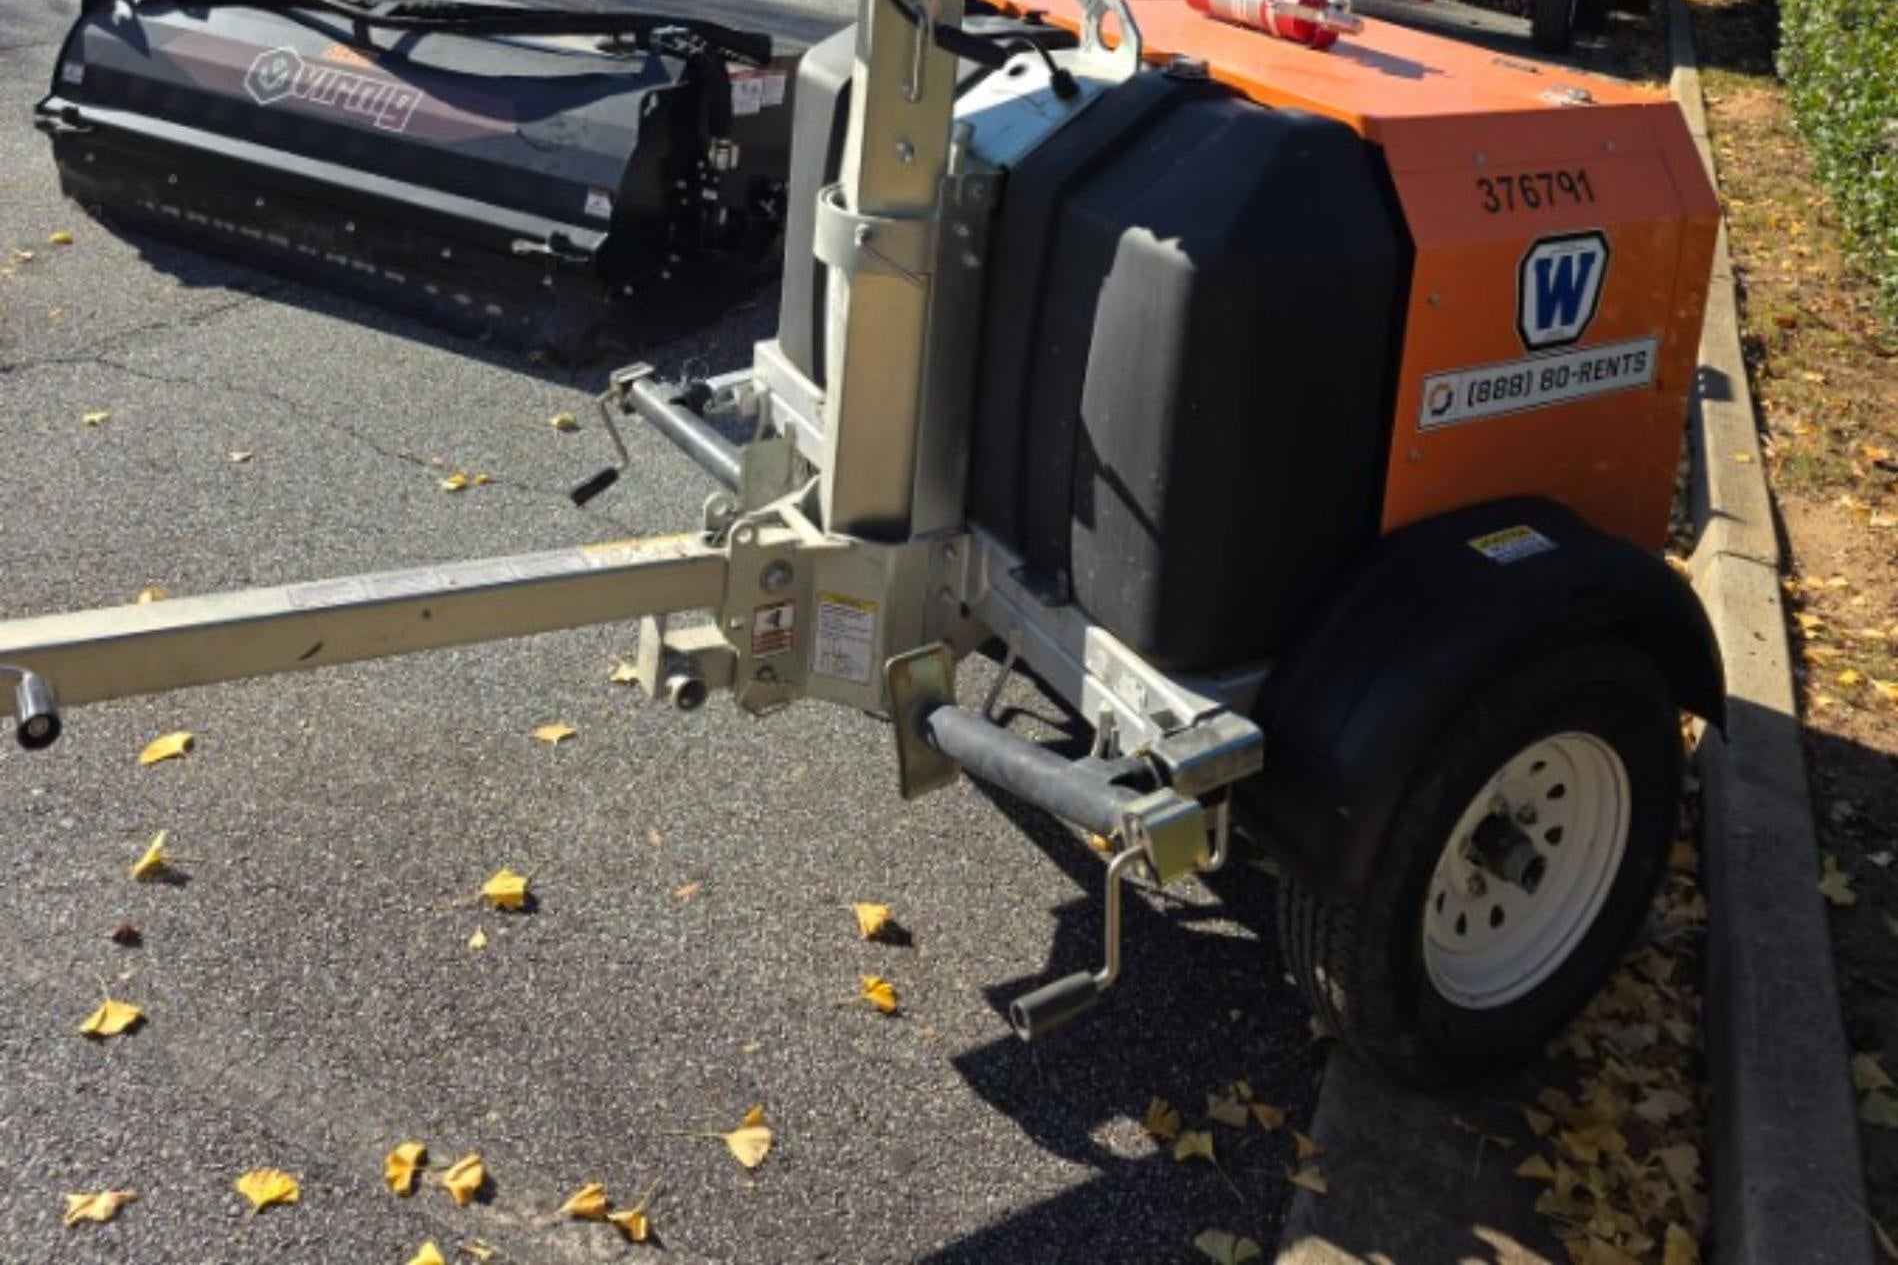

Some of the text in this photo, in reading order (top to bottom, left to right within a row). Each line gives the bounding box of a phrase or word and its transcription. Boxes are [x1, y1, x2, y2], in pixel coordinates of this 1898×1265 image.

[1476, 168, 1596, 214] 376791
[1534, 251, 1597, 331] W
[1466, 371, 1533, 407] (888)
